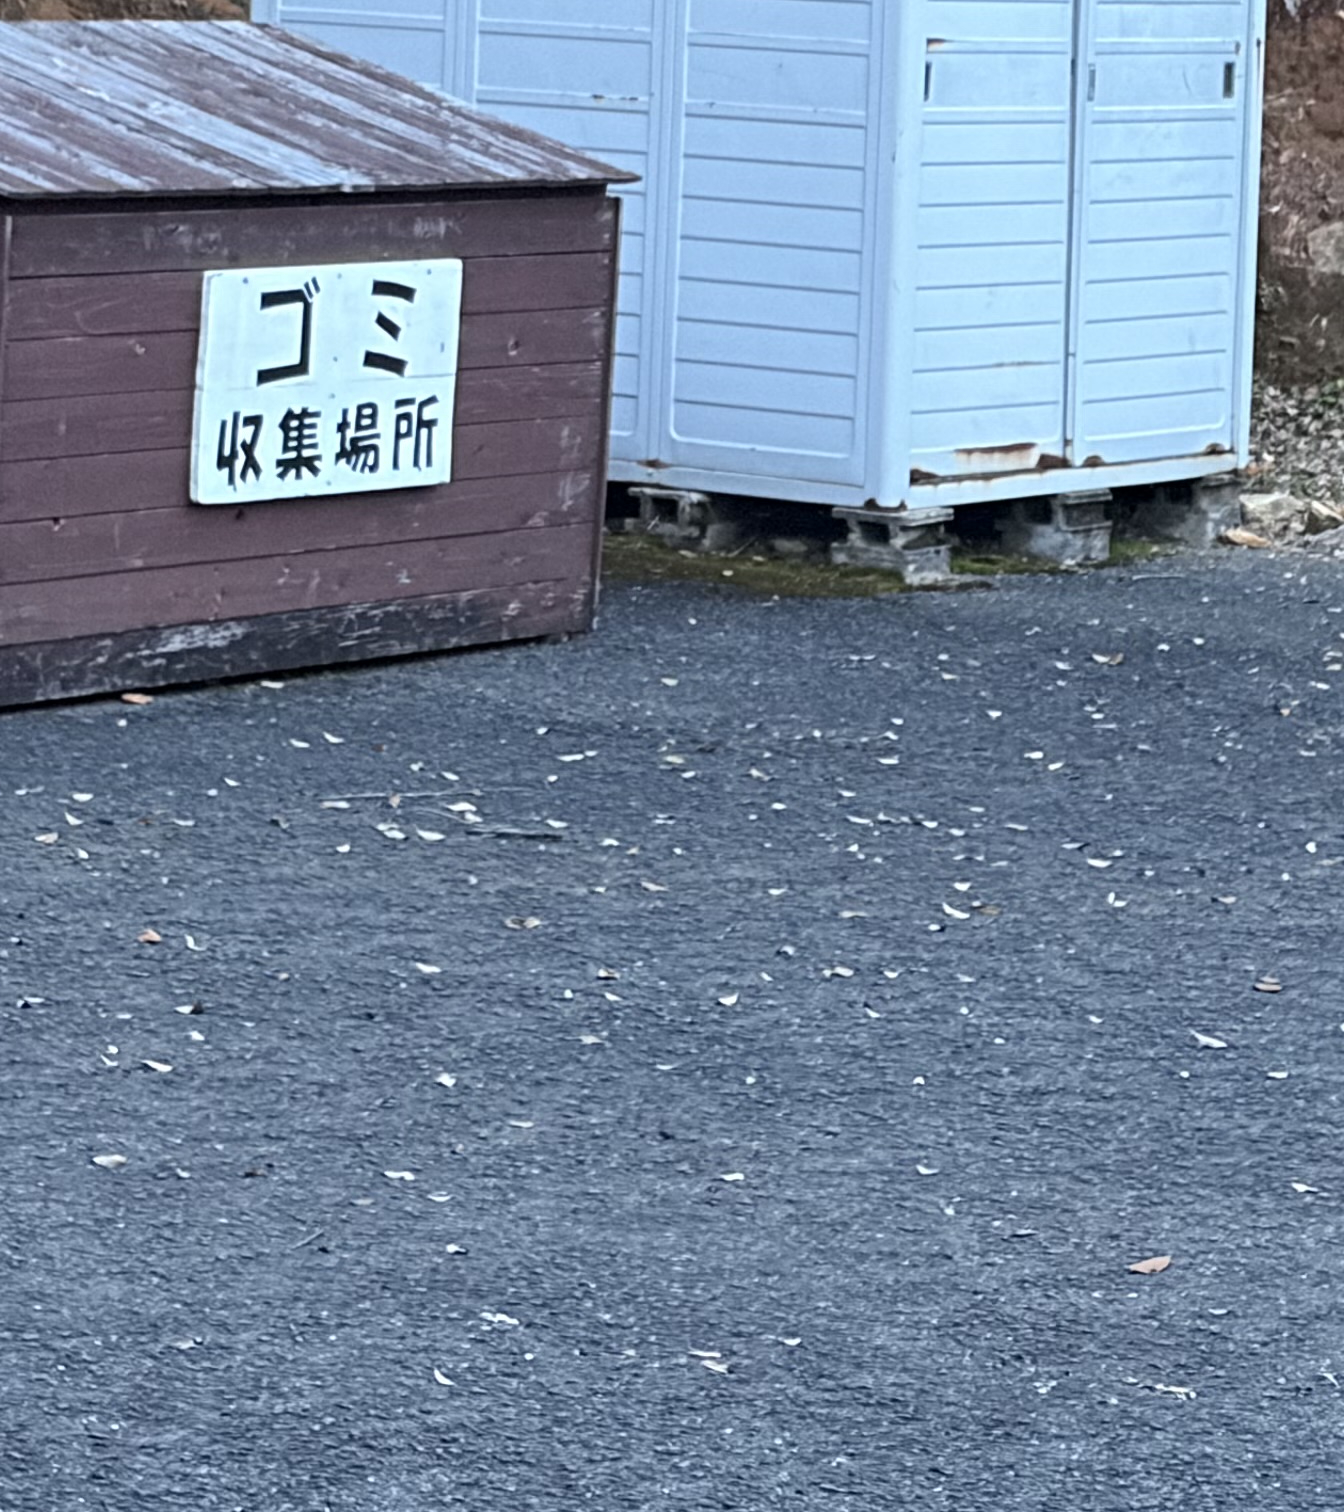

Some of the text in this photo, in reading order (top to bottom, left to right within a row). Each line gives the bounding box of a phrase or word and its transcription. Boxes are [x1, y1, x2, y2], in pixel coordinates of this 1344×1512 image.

[256, 277, 417, 387] ゴミ
[216, 395, 439, 491] 収集場所
